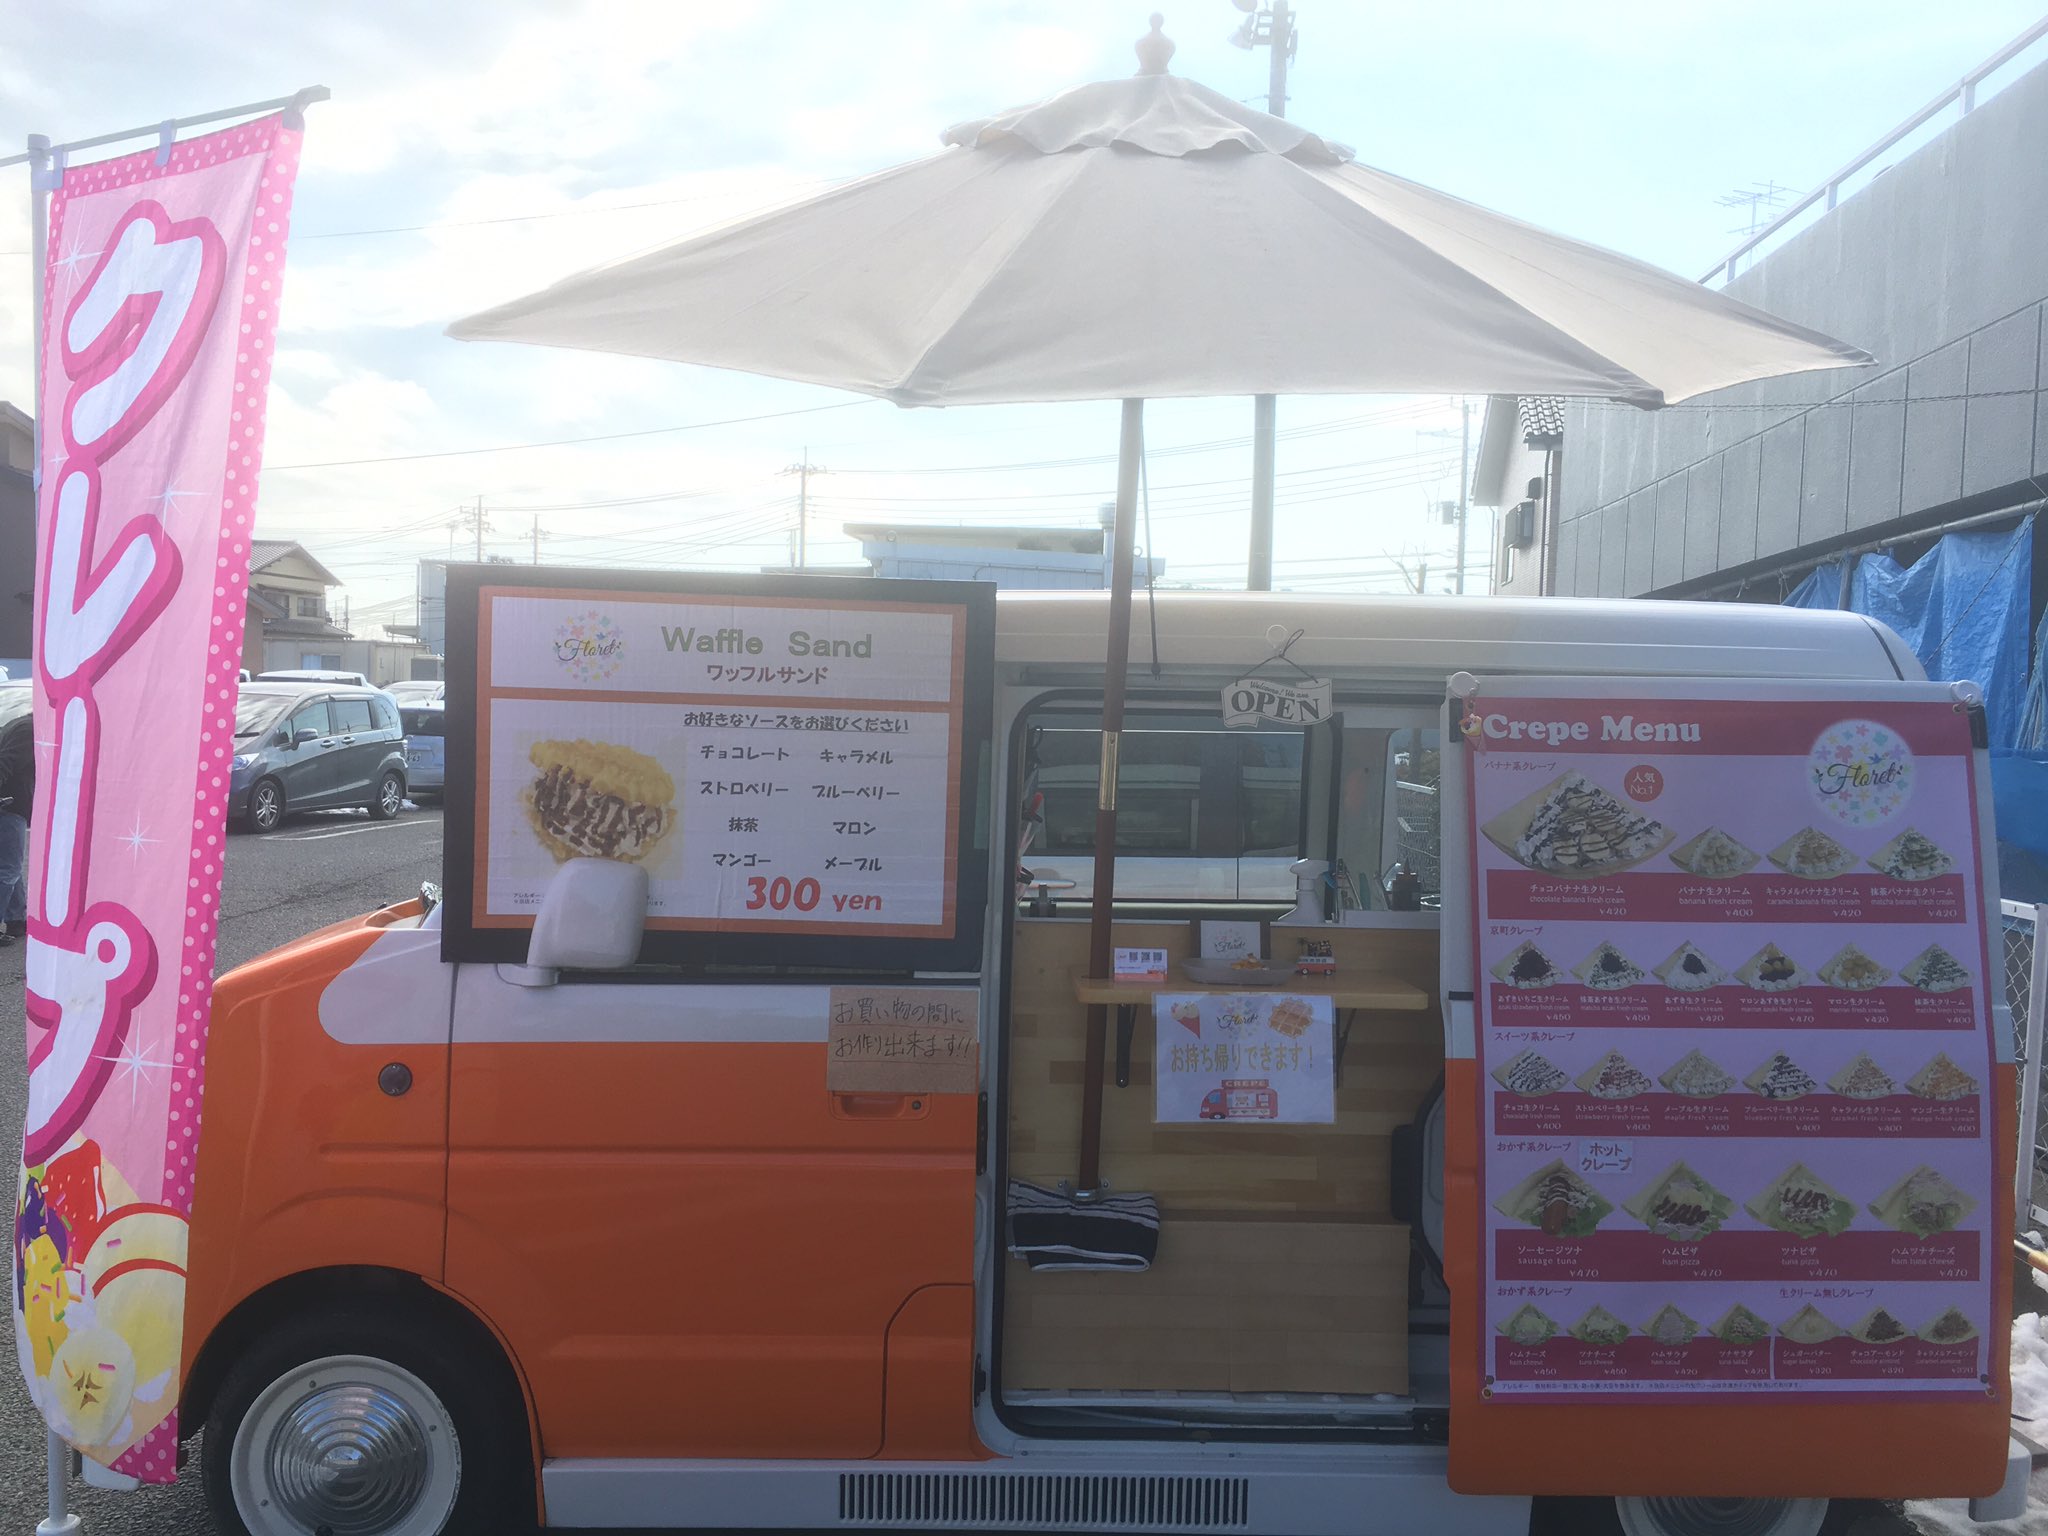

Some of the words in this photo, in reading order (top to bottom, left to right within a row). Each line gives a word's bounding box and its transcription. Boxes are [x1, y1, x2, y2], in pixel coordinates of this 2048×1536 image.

[556, 637, 618, 662] Floret
[660, 626, 764, 655] Waffle
[788, 630, 873, 659] Sand
[25, 198, 226, 1167] クレープ
[706, 664, 830, 685] ワッフルサンド
[1231, 690, 1320, 721] OPEN
[683, 711, 910, 733] お好きなソースをお選びください
[1482, 713, 1590, 746] Crepe
[1600, 714, 1702, 743] Menu
[699, 744, 790, 762] チョコレート
[820, 748, 894, 765] キャラメル
[1632, 770, 1655, 783] 人気
[1817, 761, 1899, 795] Floret
[699, 780, 789, 798] ストロベリー
[1630, 785, 1654, 796] No.1
[728, 816, 759, 833] 抹茶
[832, 821, 877, 836] マロン
[712, 853, 772, 868] マンゴー
[745, 876, 822, 912] 300
[832, 893, 883, 913] yen
[1679, 897, 1706, 905] banana
[1708, 897, 1727, 905] fresh
[1730, 897, 1753, 905] cream
[833, 996, 965, 1024] お買い物の間に
[1170, 1042, 1314, 1073] お持ち帰りできます！
[1225, 1080, 1267, 1088] CREPE
[1589, 1142, 1625, 1157] ホット
[1581, 1157, 1633, 1172] クレープ
[1518, 1257, 1553, 1266] sausage
[1556, 1257, 1577, 1266] tuna
[1662, 1257, 1678, 1267] ham
[1680, 1257, 1700, 1267] pizza
[1782, 1257, 1798, 1266] tuna
[1800, 1257, 1819, 1266] pizza
